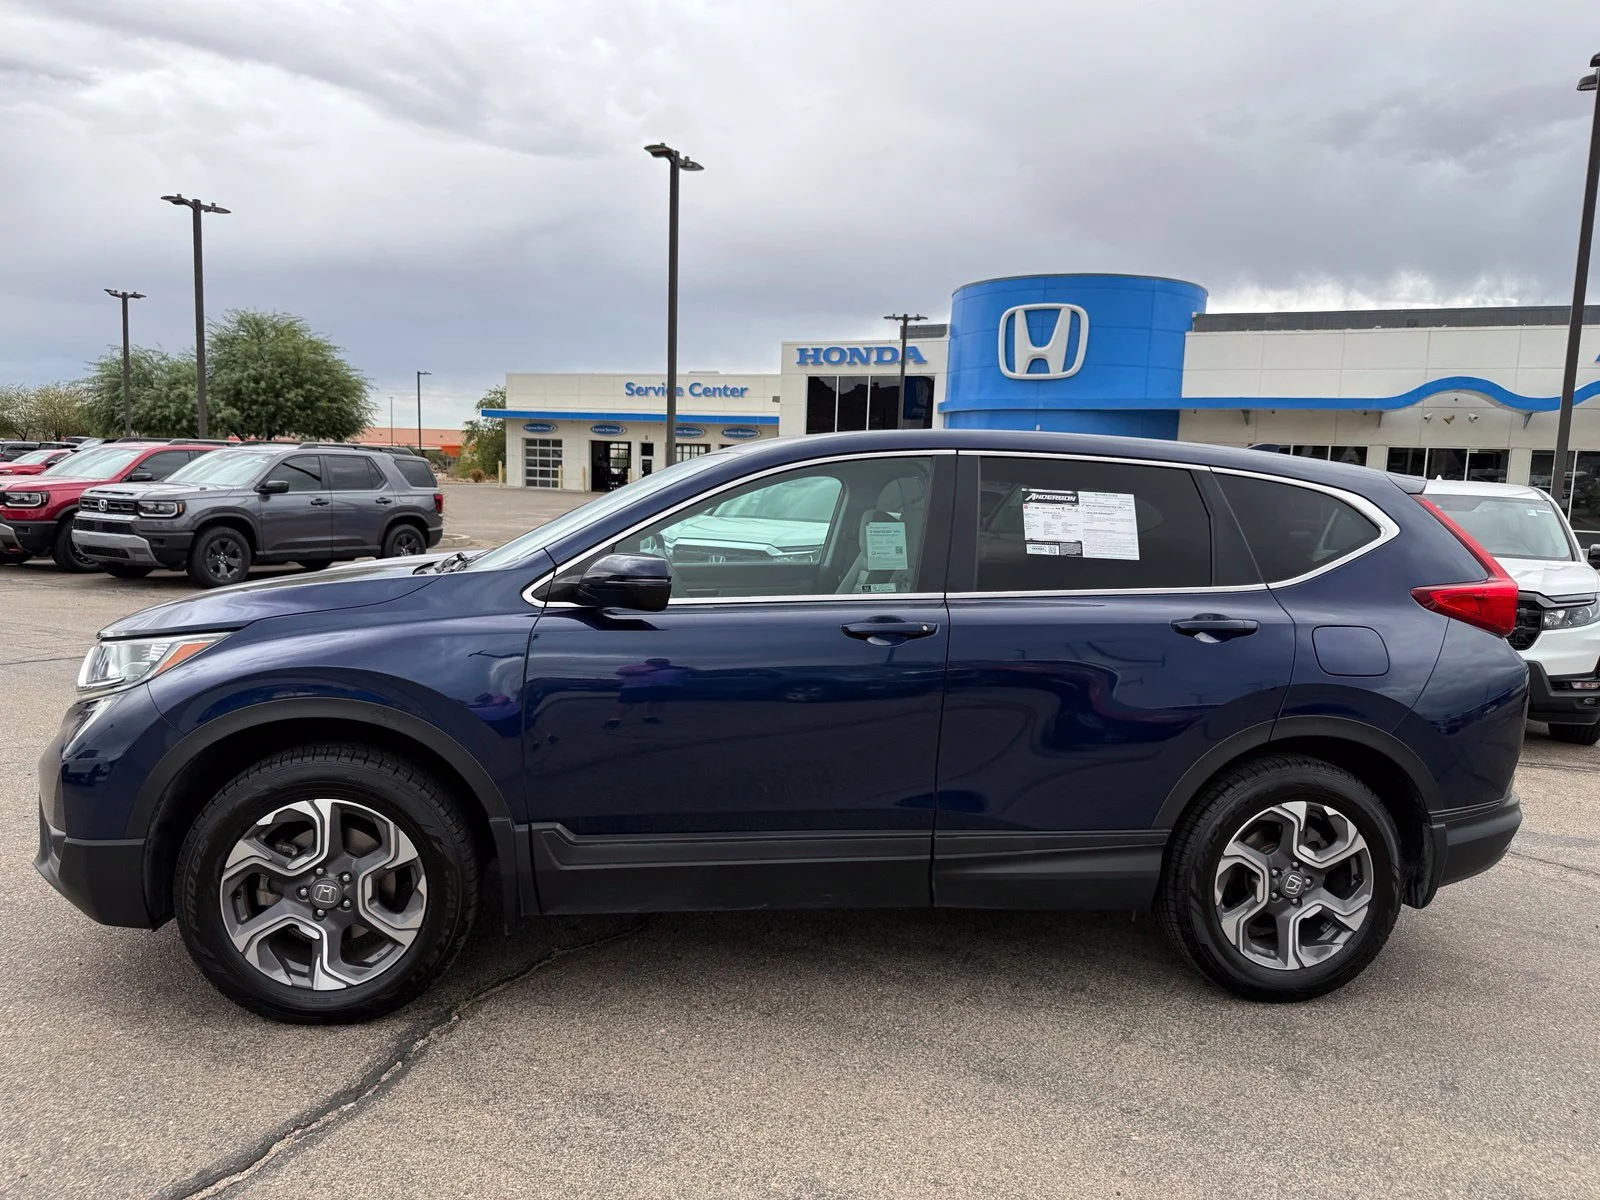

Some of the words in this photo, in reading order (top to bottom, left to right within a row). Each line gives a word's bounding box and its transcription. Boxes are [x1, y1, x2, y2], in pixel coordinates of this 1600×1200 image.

[796, 346, 928, 366] HONDA
[624, 381, 684, 398] Servie
[688, 382, 748, 398] Center
